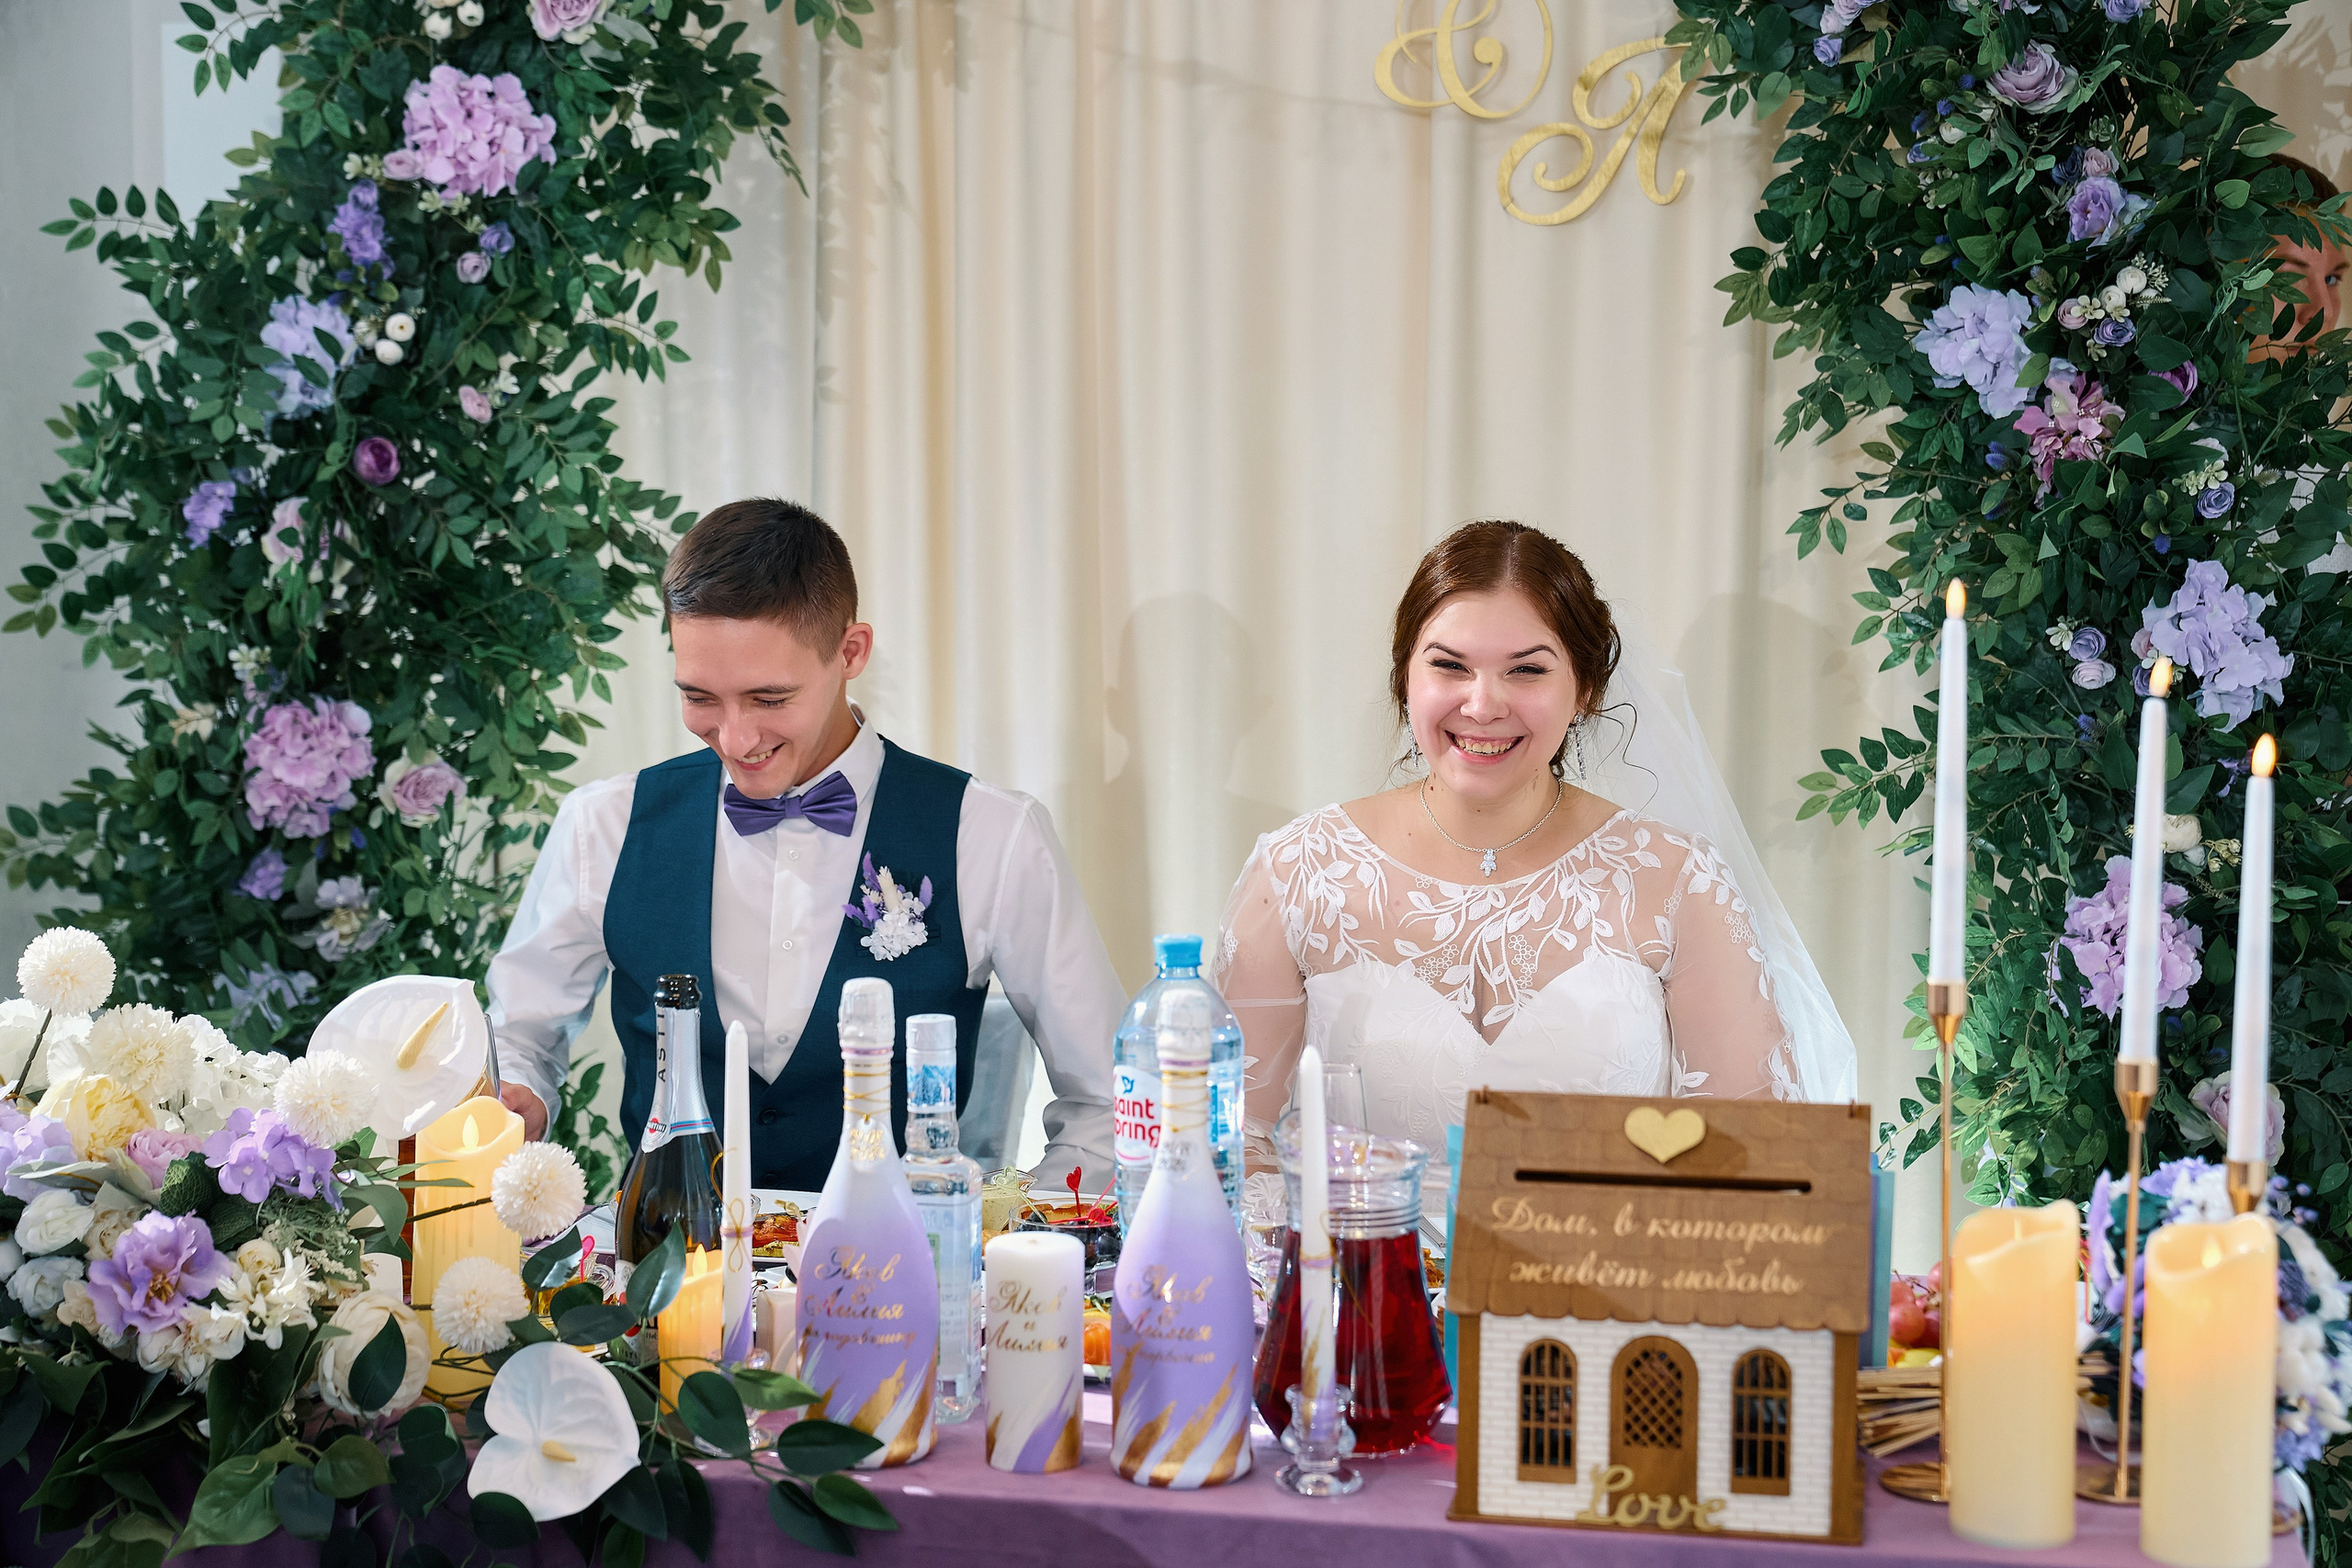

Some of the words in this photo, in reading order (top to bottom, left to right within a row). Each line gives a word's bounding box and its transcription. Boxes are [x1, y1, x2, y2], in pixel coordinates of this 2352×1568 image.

[657, 1013, 666, 1082] ASTI
[1114, 1118, 1160, 1148] pring
[1613, 1201, 1640, 1237] в
[1646, 1216, 1828, 1253] котором
[1510, 1249, 1654, 1288] живёт
[1662, 1256, 1806, 1294] любовь
[1576, 1463, 1727, 1532] Love
